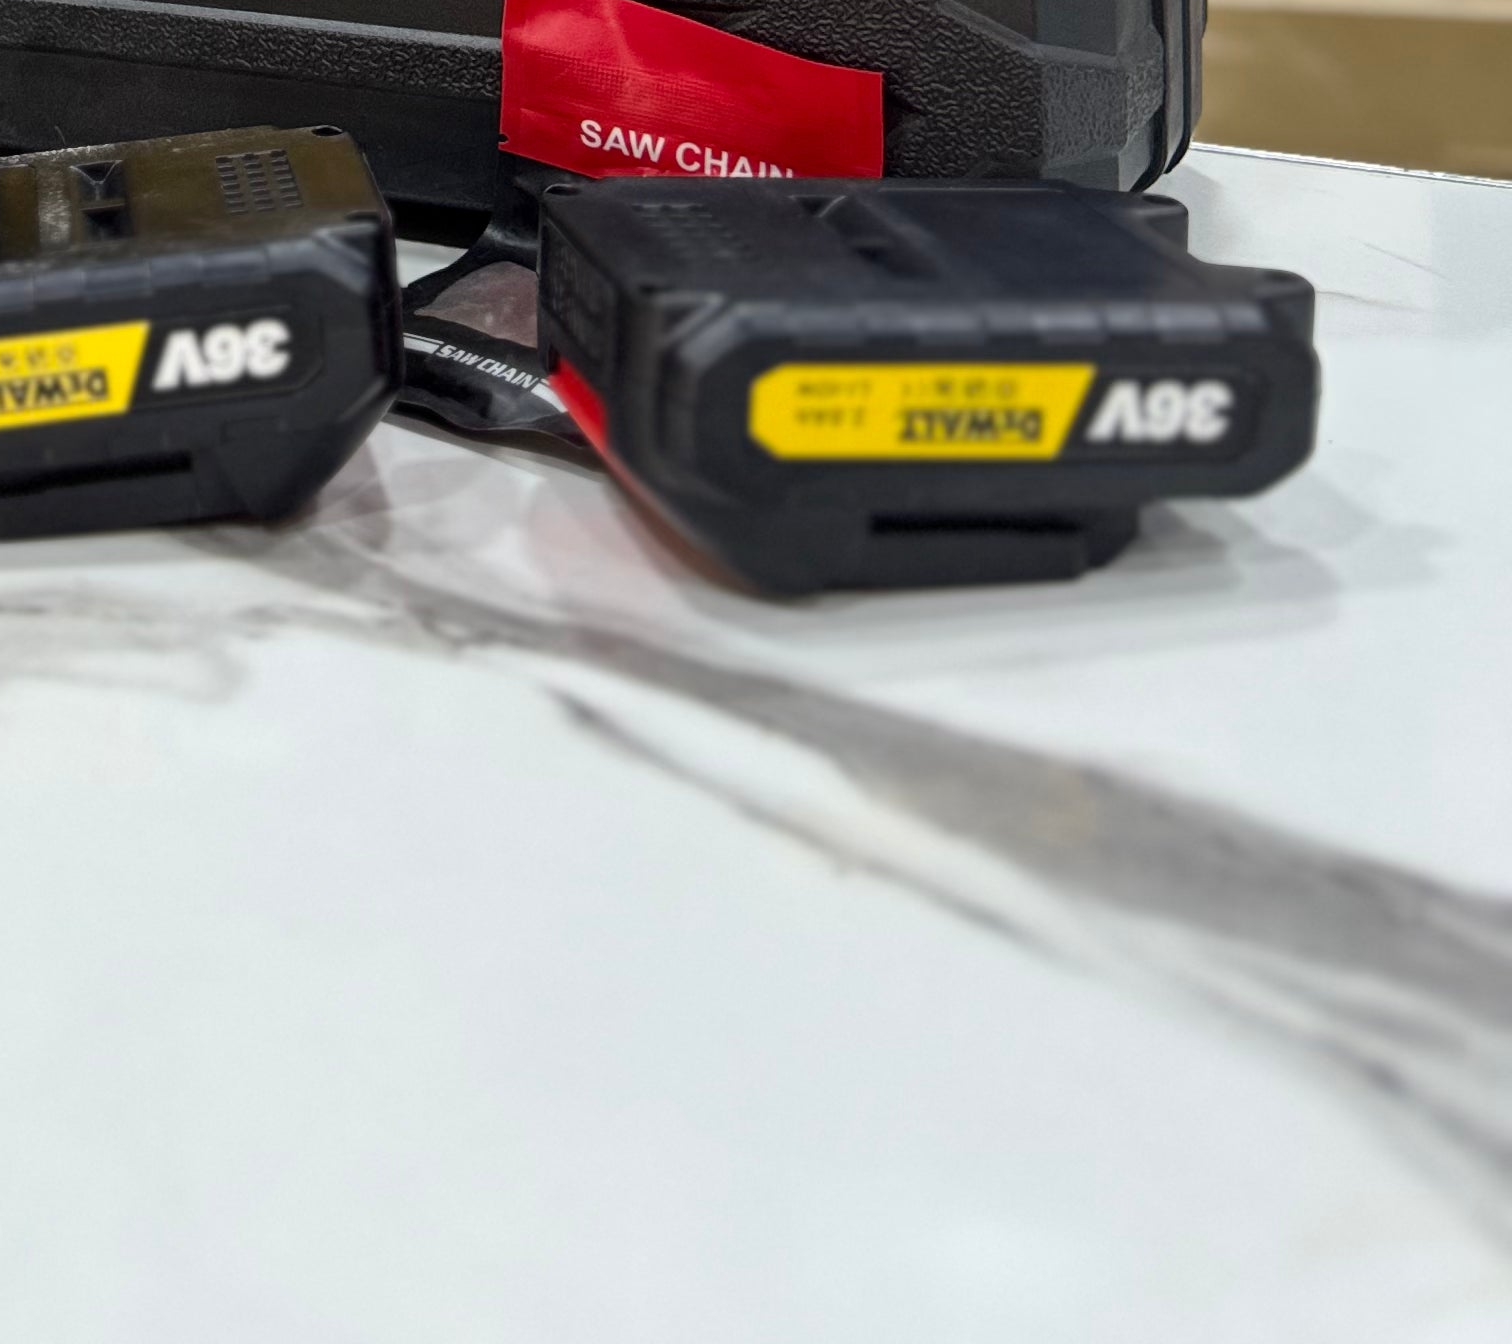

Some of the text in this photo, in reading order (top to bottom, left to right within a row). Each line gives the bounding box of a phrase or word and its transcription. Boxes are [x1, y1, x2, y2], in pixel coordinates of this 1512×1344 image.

[580, 119, 665, 163] SAW
[153, 319, 290, 392] 36V
[435, 344, 539, 389] SAW CHAIN
[1088, 380, 1233, 443] 36V
